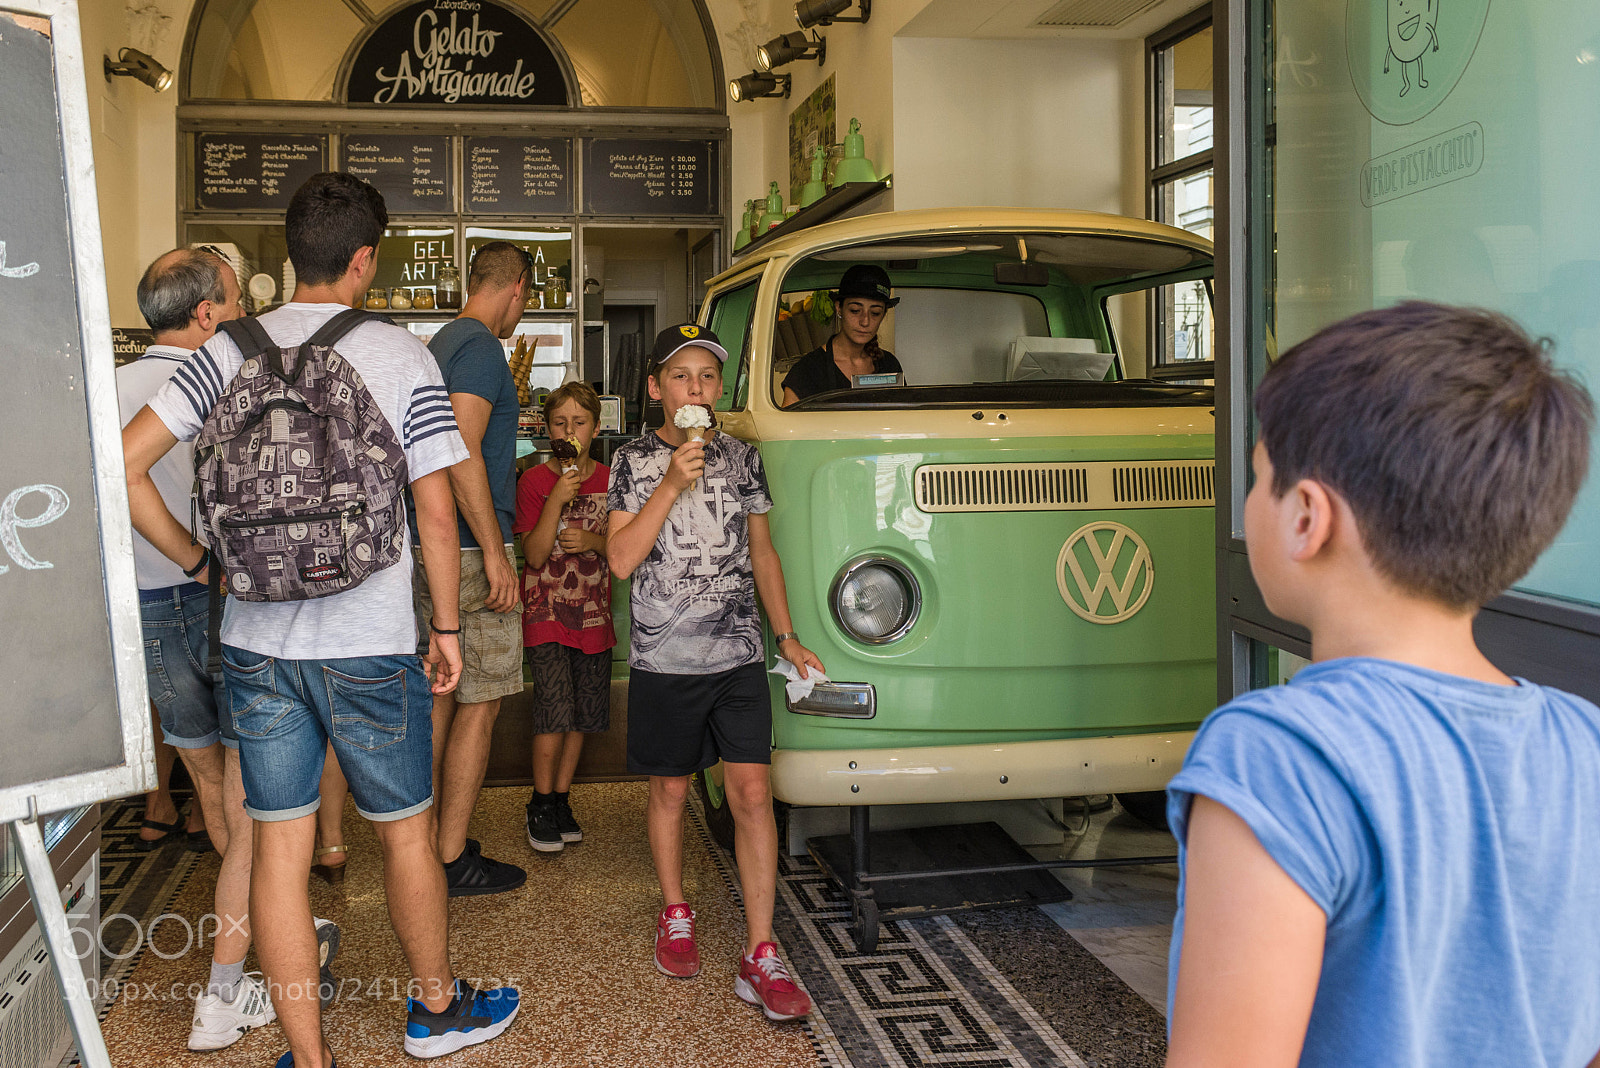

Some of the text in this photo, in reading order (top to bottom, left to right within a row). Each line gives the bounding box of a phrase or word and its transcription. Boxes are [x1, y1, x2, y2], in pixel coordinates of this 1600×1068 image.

[413, 9, 503, 69] Gelato
[373, 50, 535, 104] Artigianale
[1365, 160, 1398, 199] VERDE
[1400, 132, 1475, 189] PISTACCHIO
[239, 396, 248, 409] 8
[264, 479, 293, 494] 3 8
[320, 523, 329, 538] 3
[306, 569, 338, 578] EASTPAK
[1056, 521, 1155, 625] VW
[664, 578, 700, 594] NEW
[689, 594, 723, 609] CITY
